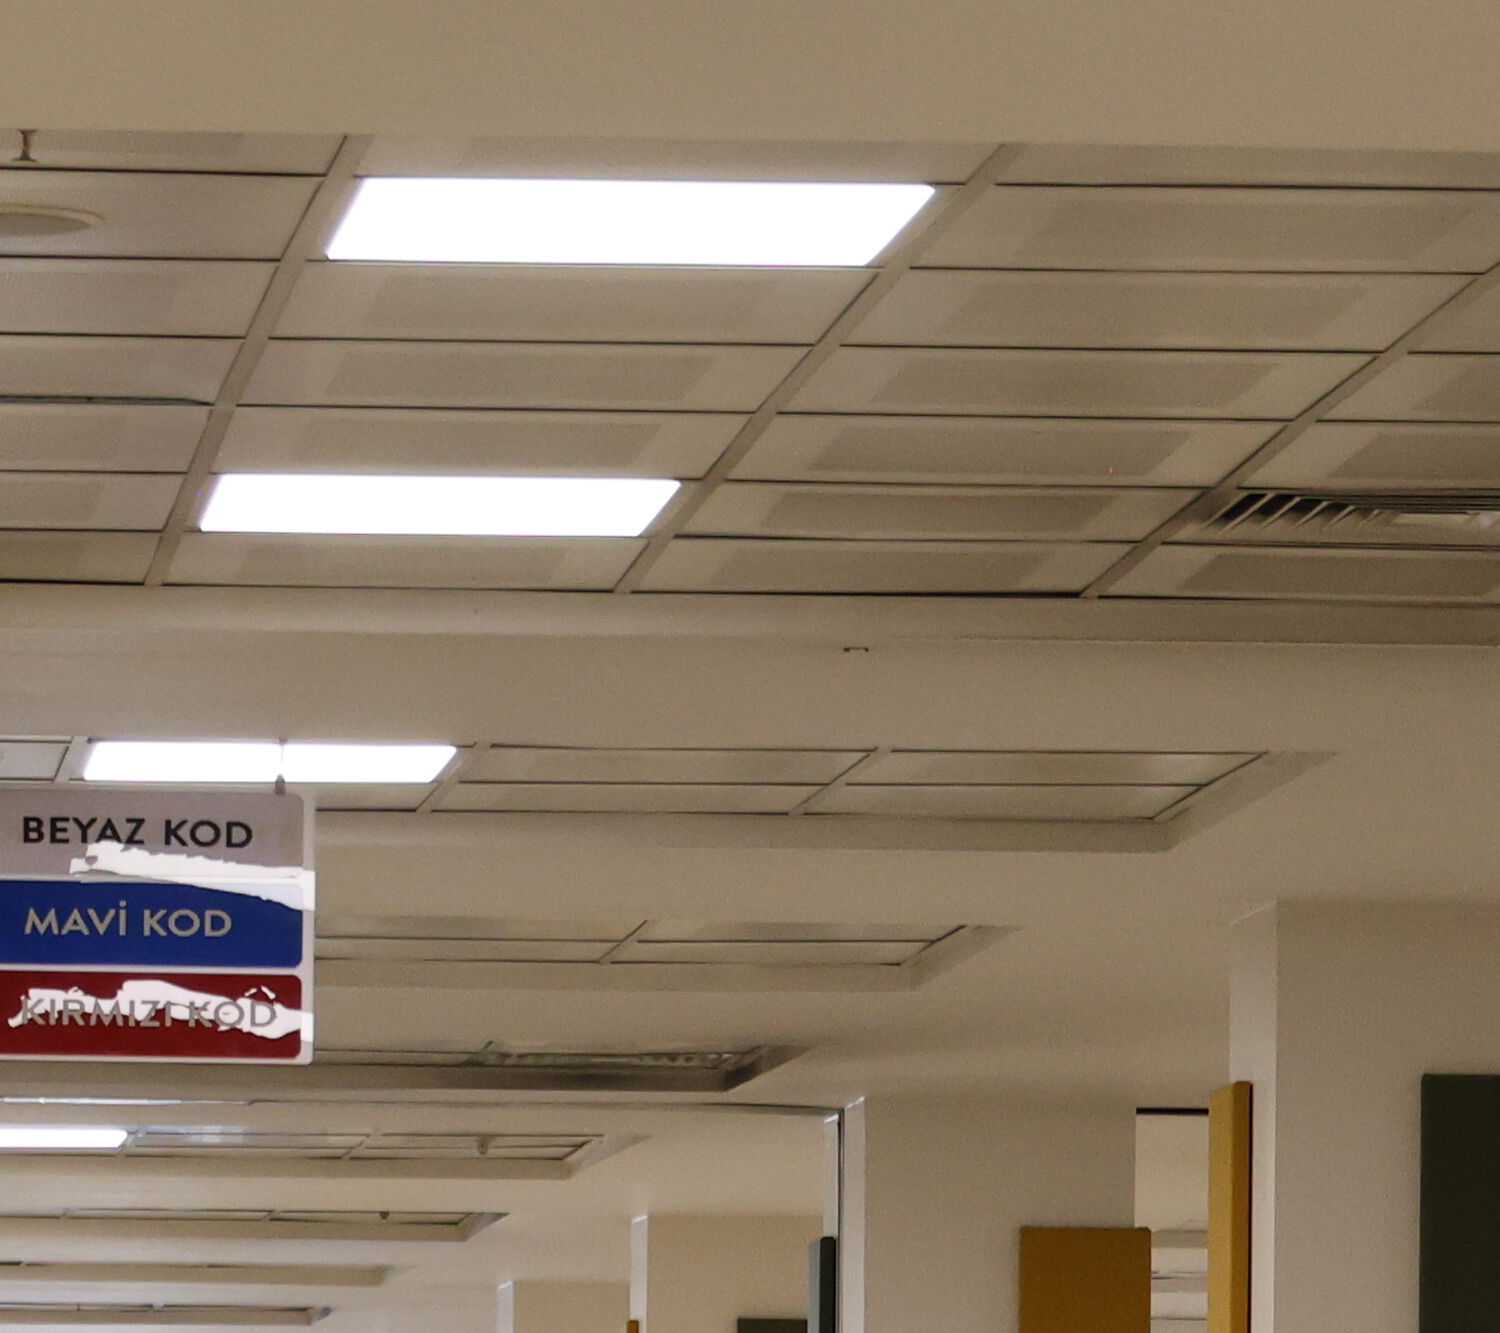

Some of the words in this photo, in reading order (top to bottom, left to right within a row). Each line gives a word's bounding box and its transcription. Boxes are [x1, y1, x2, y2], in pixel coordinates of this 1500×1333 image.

[22, 816, 146, 846] BEYAZ
[163, 819, 254, 849] KOD
[23, 900, 128, 936] MAVİ
[142, 908, 233, 938] KOD
[21, 998, 174, 1028] KIRMIZI
[188, 1000, 278, 1028] KOD
